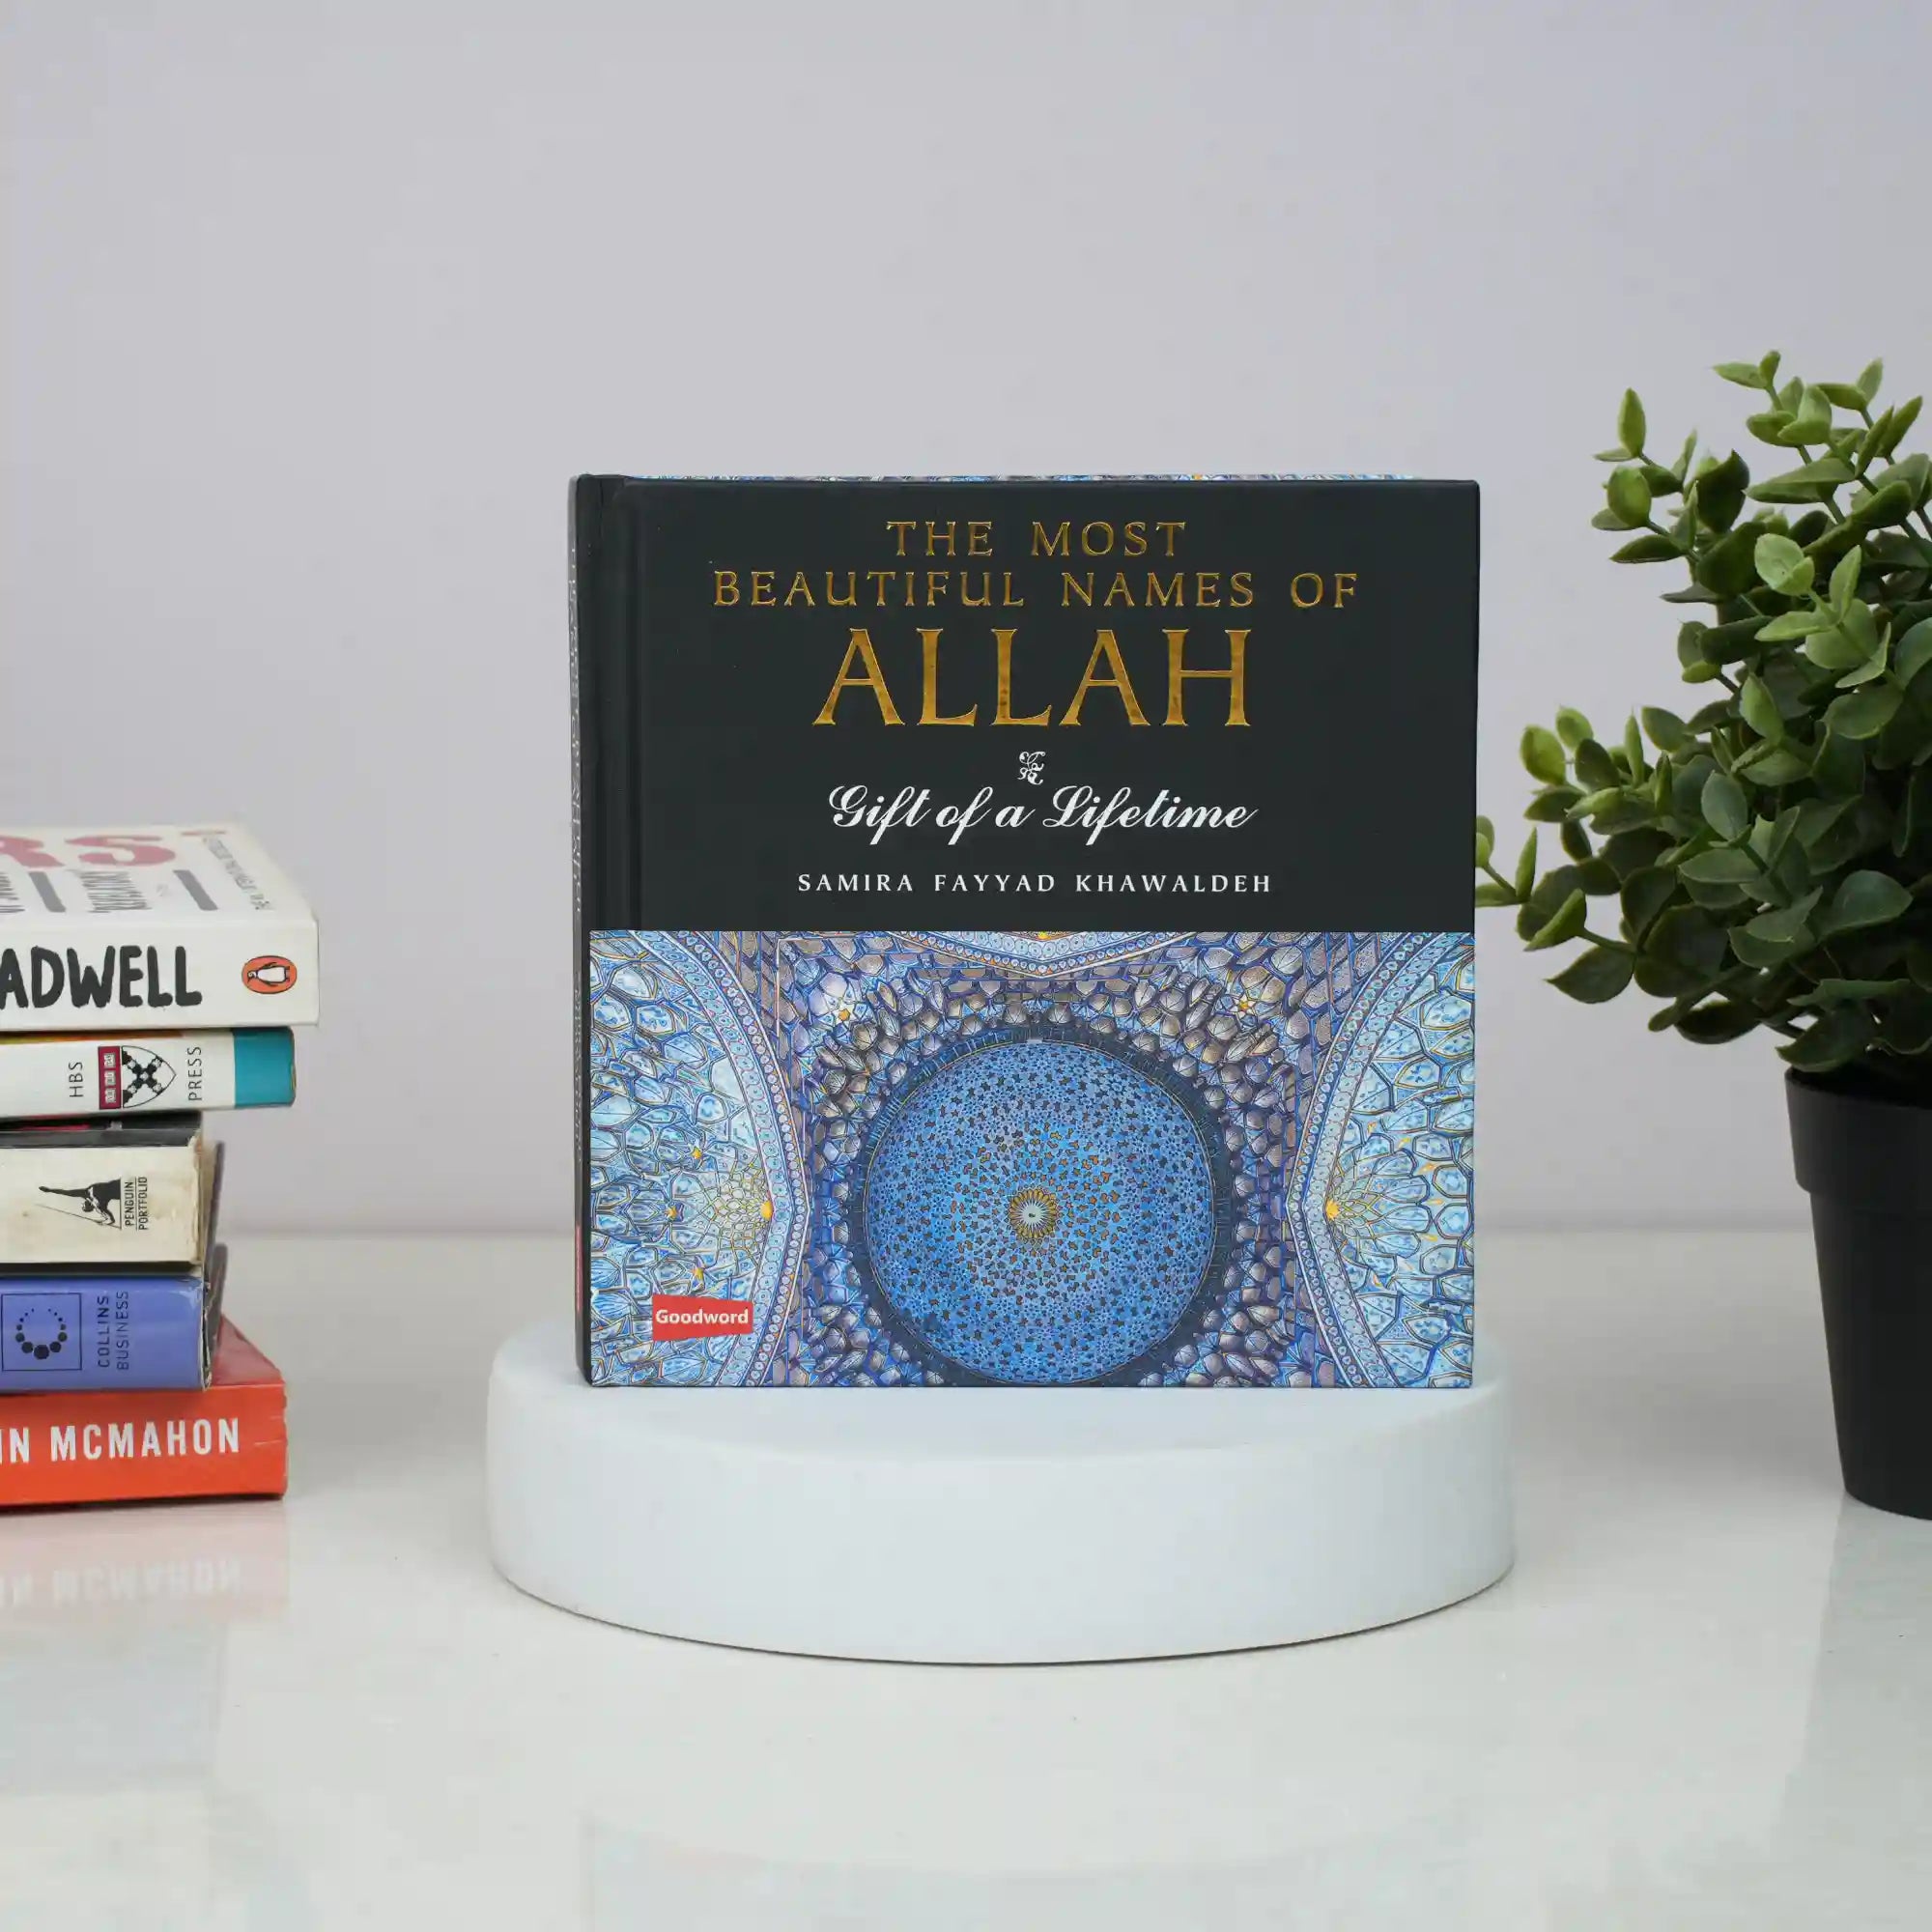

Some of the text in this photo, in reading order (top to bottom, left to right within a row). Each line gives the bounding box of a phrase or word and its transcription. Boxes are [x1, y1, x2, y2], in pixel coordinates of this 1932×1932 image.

[886, 521, 1186, 557] THE MOST
[713, 570, 1357, 609] BEAUTIFUL NAMES OF
[811, 627, 1252, 727] ALLAH
[828, 784, 1260, 846] Gift of a Lifetime
[798, 873, 1269, 893] SAMIRA FAYYAD KHAWALDEH
[0, 945, 203, 1010] ADWELL
[68, 1061, 84, 1098] HBS
[185, 1045, 203, 1101] PRESS
[124, 1180, 134, 1227] PENGUIN
[137, 1177, 149, 1230] PORTFOLIO
[97, 1294, 110, 1369] COLLINS
[115, 1290, 129, 1371] BUSINESS
[655, 1307, 750, 1324] Goodword
[50, 1418, 240, 1463] MCMAHON
